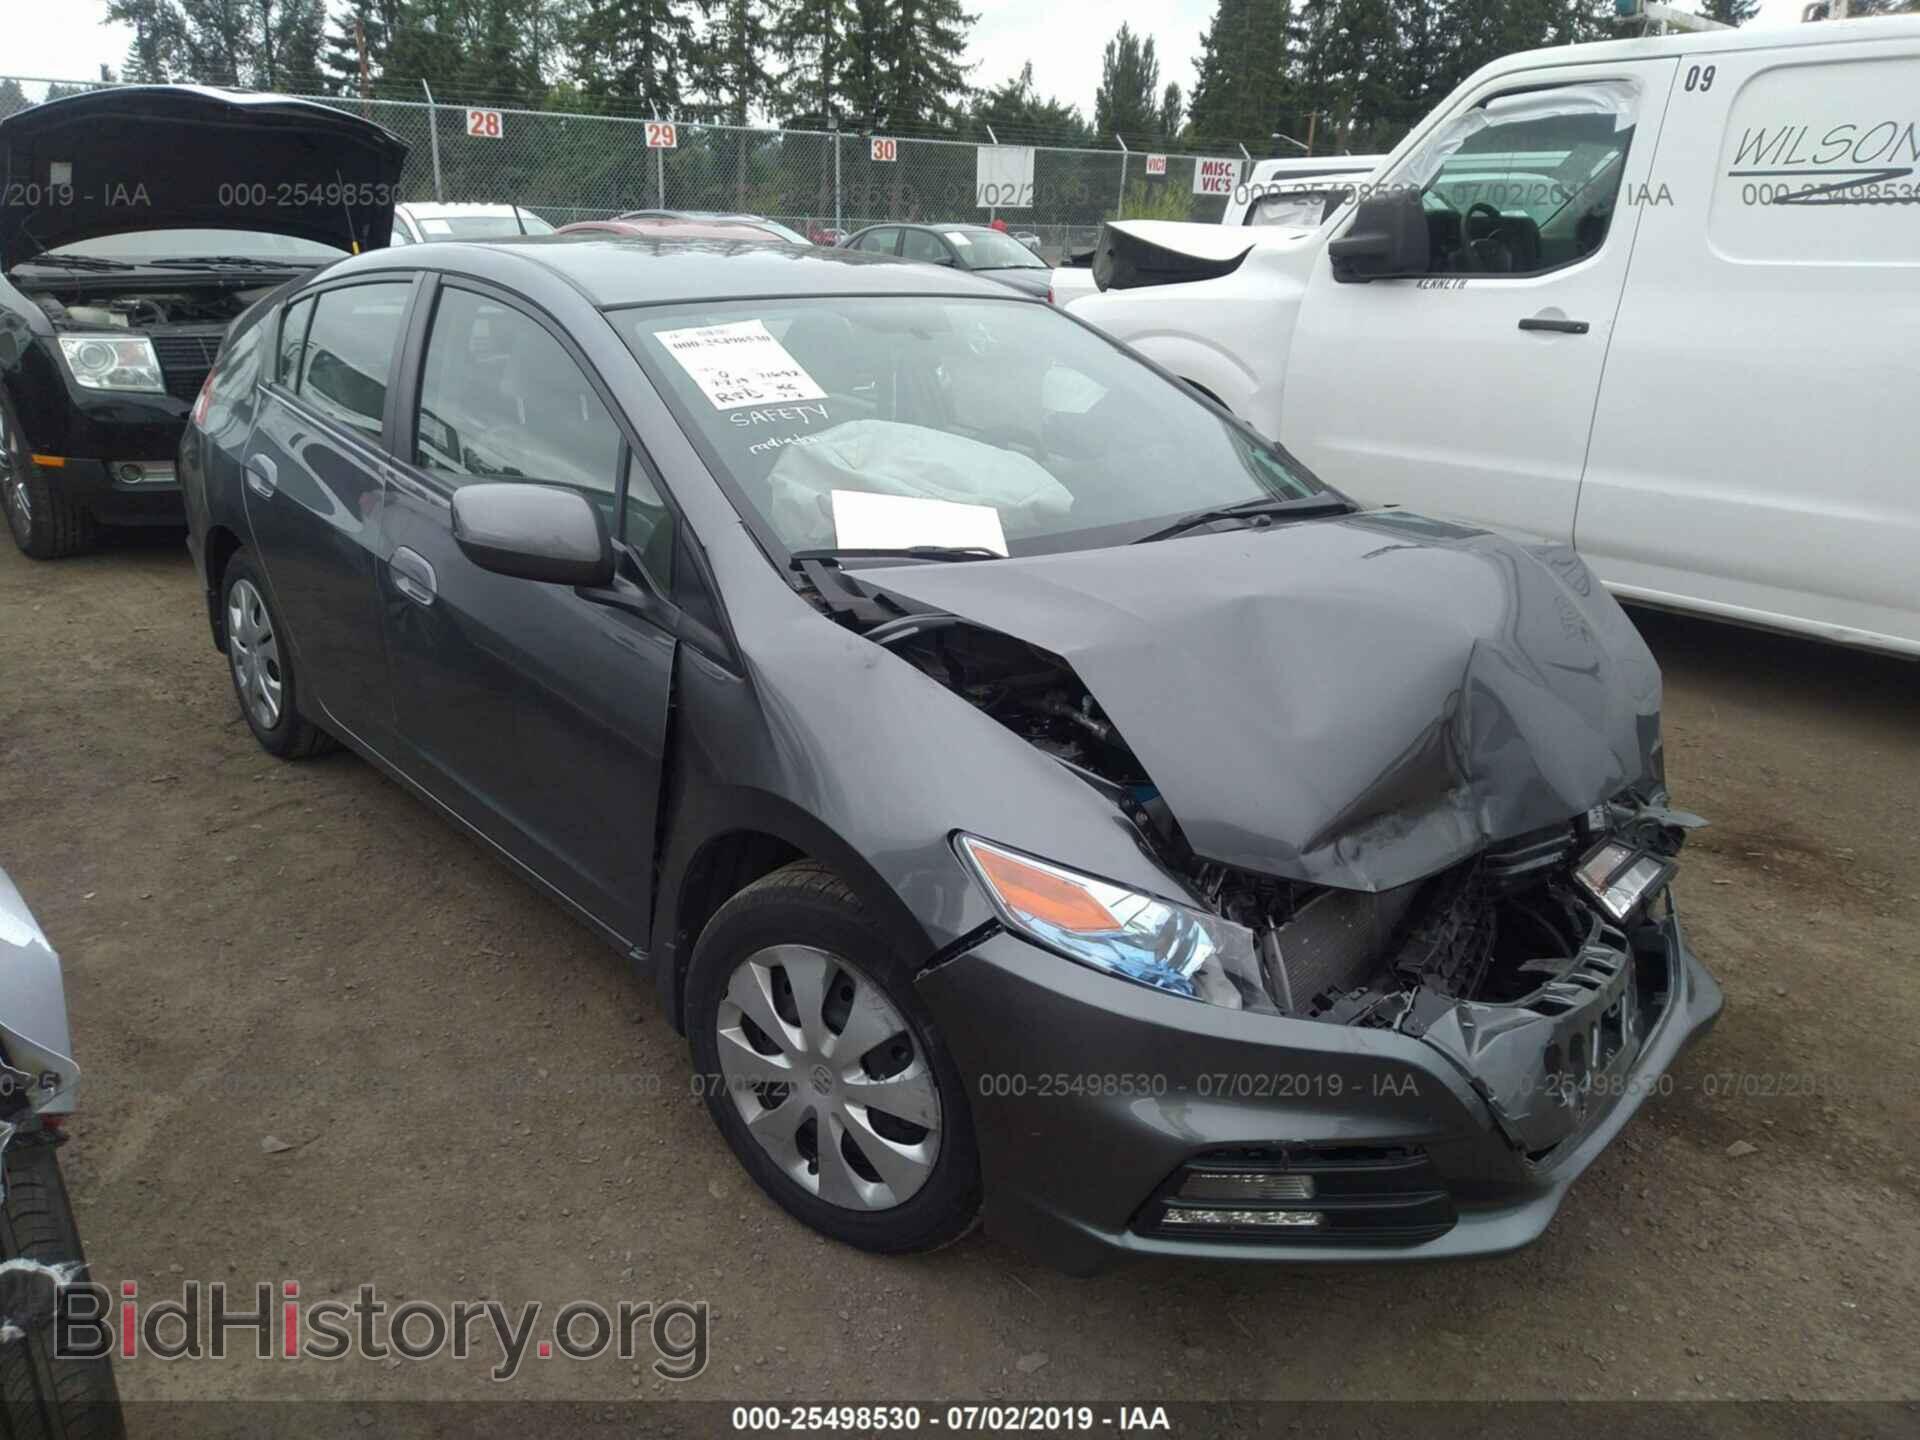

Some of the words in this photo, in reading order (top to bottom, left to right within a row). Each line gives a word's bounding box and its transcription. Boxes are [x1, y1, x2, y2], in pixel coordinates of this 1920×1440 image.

[1684, 65, 1716, 92] 09
[470, 111, 499, 136] 28
[648, 124, 674, 146] 29
[873, 140, 895, 160] 30
[1734, 121, 1920, 165] WILSON
[1202, 162, 1236, 177] MISC.
[1202, 177, 1231, 192] VIC'S
[730, 403, 829, 427] SAFETY
